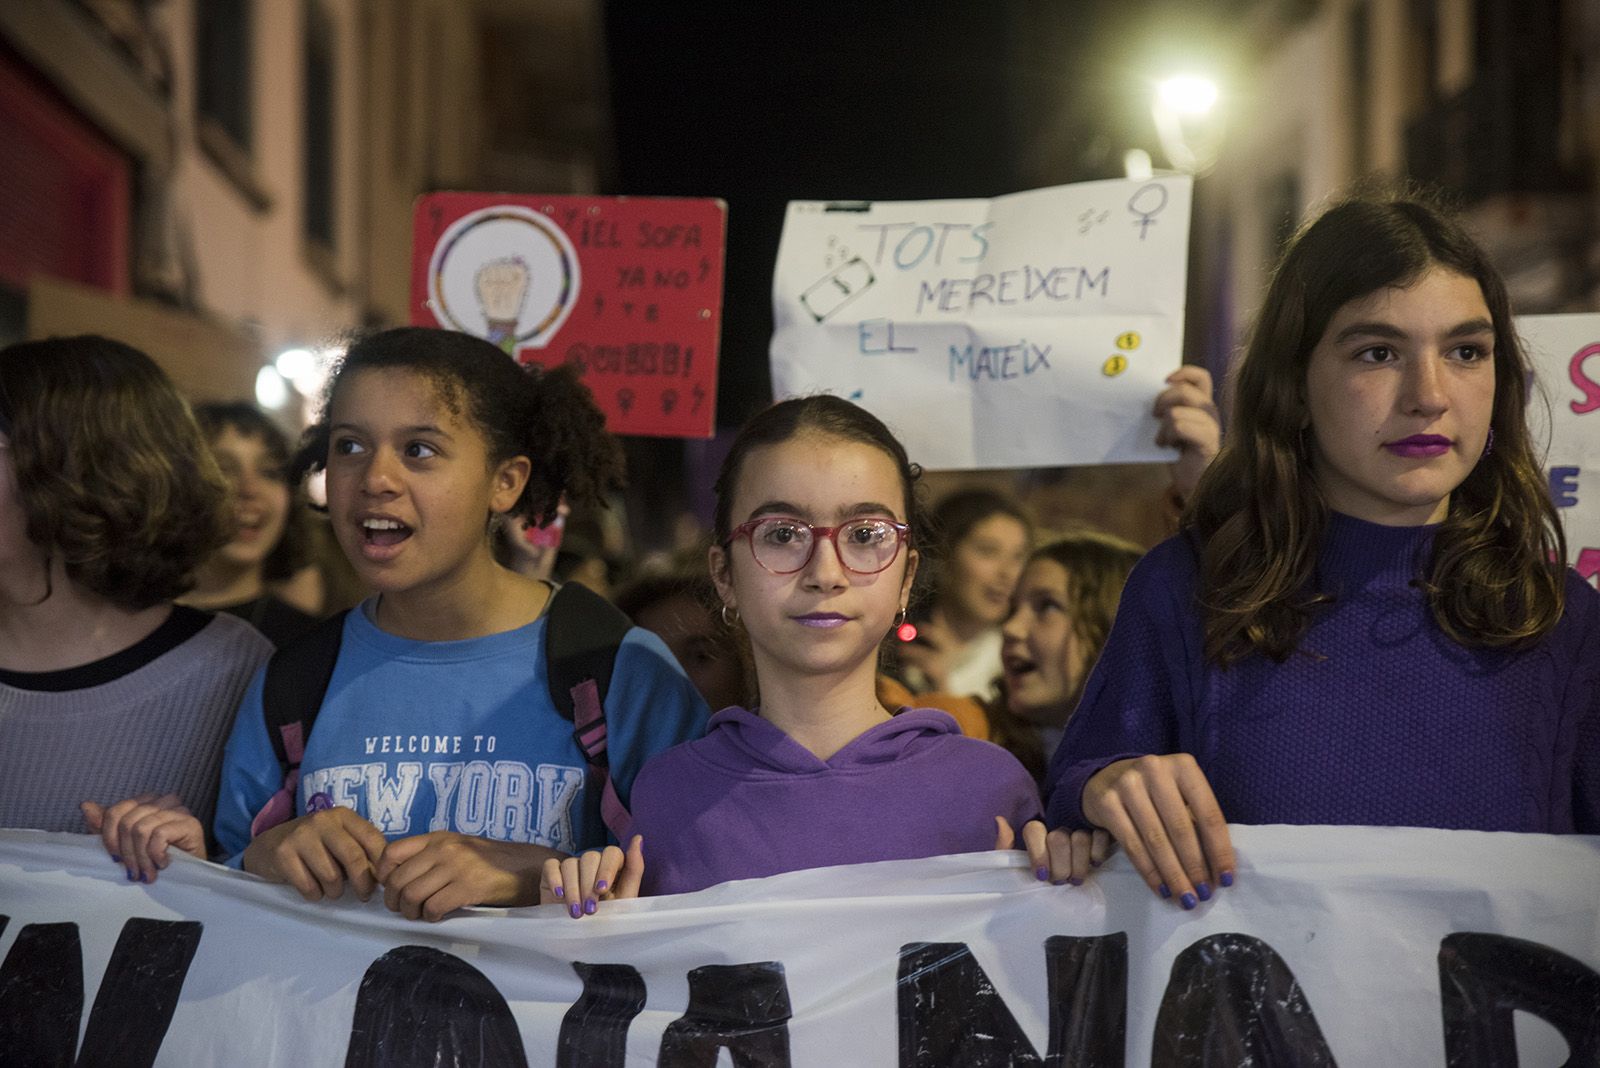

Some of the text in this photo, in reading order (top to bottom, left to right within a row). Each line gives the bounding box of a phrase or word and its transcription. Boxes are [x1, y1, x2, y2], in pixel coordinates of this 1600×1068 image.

[857, 221, 994, 271] TOTS
[653, 267, 690, 290] NO
[858, 318, 919, 356] EL
[365, 734, 498, 755] WELCOME TO
[428, 759, 585, 857] YORK
